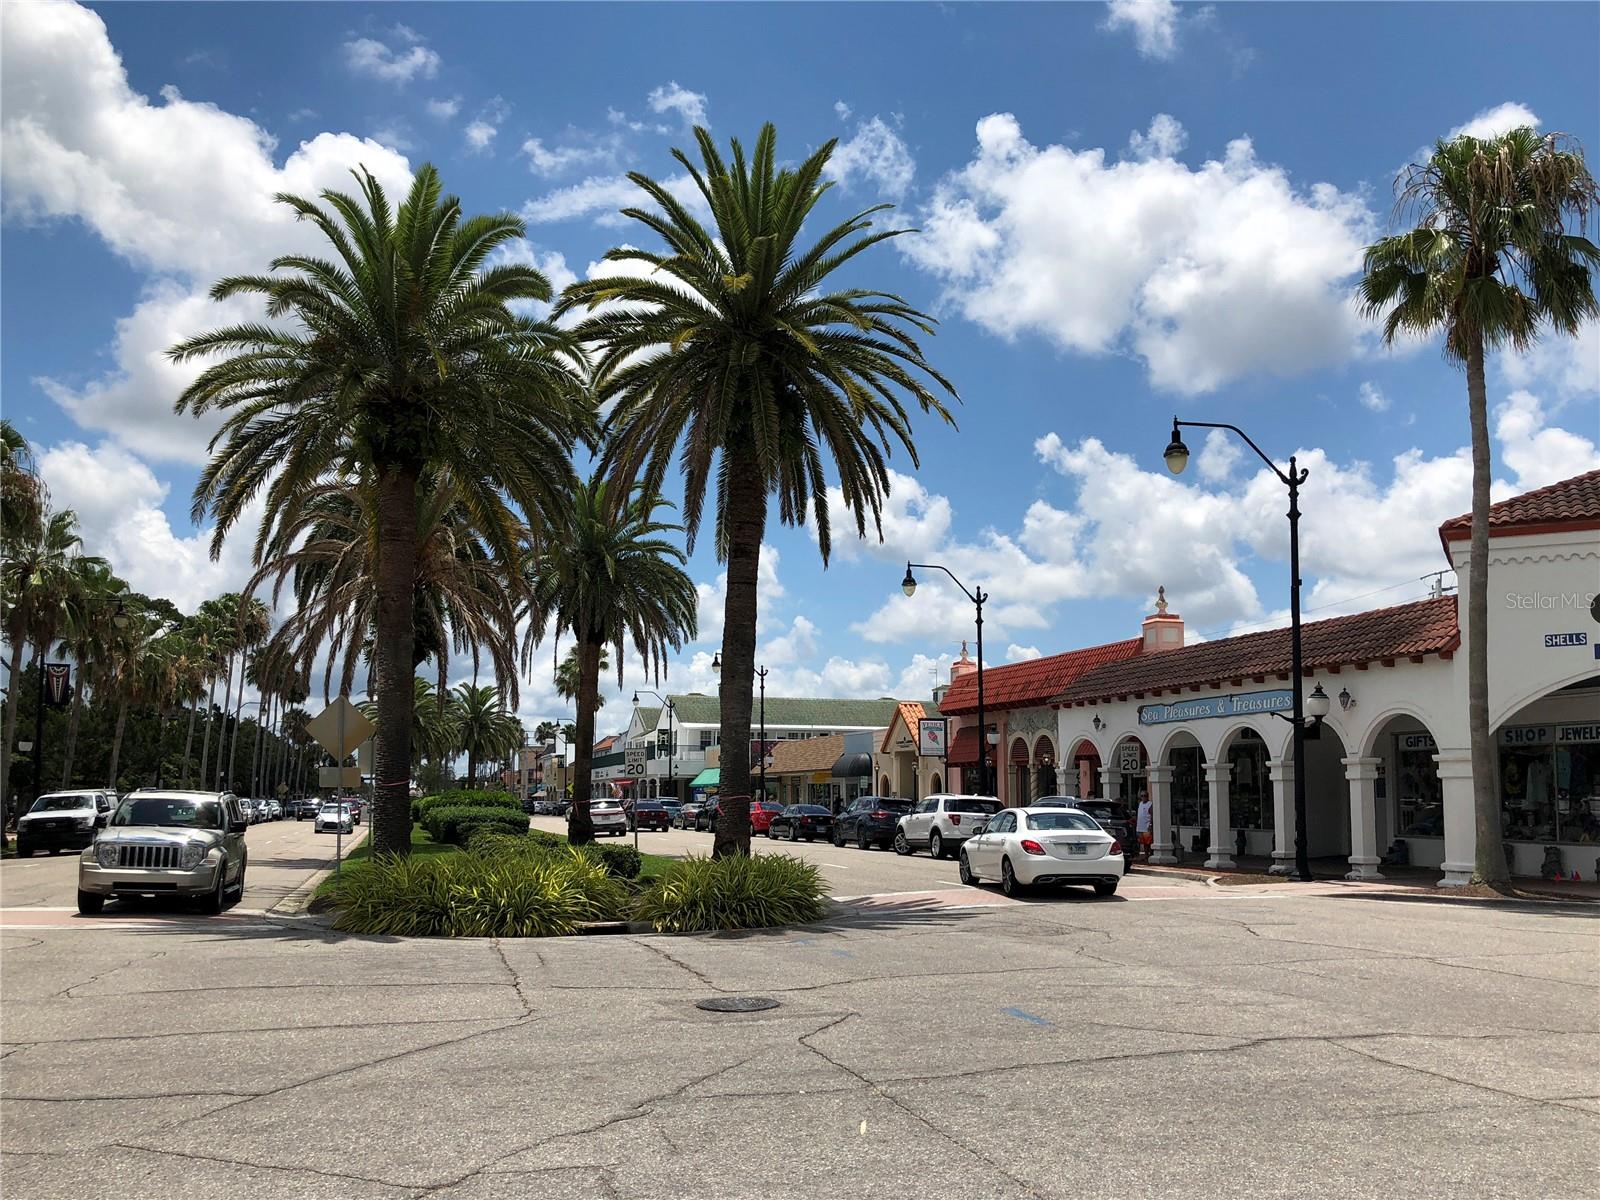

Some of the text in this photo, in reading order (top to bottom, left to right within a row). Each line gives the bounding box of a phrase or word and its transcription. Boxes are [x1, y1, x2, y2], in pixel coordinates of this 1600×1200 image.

[1545, 633, 1586, 646] SHELLS
[1141, 695, 1292, 721] Sea Pleasures & Treasures
[1406, 735, 1435, 747] GIFTS
[1504, 728, 1547, 743] SHOP
[627, 763, 644, 774] 20
[1122, 759, 1139, 771] 20
